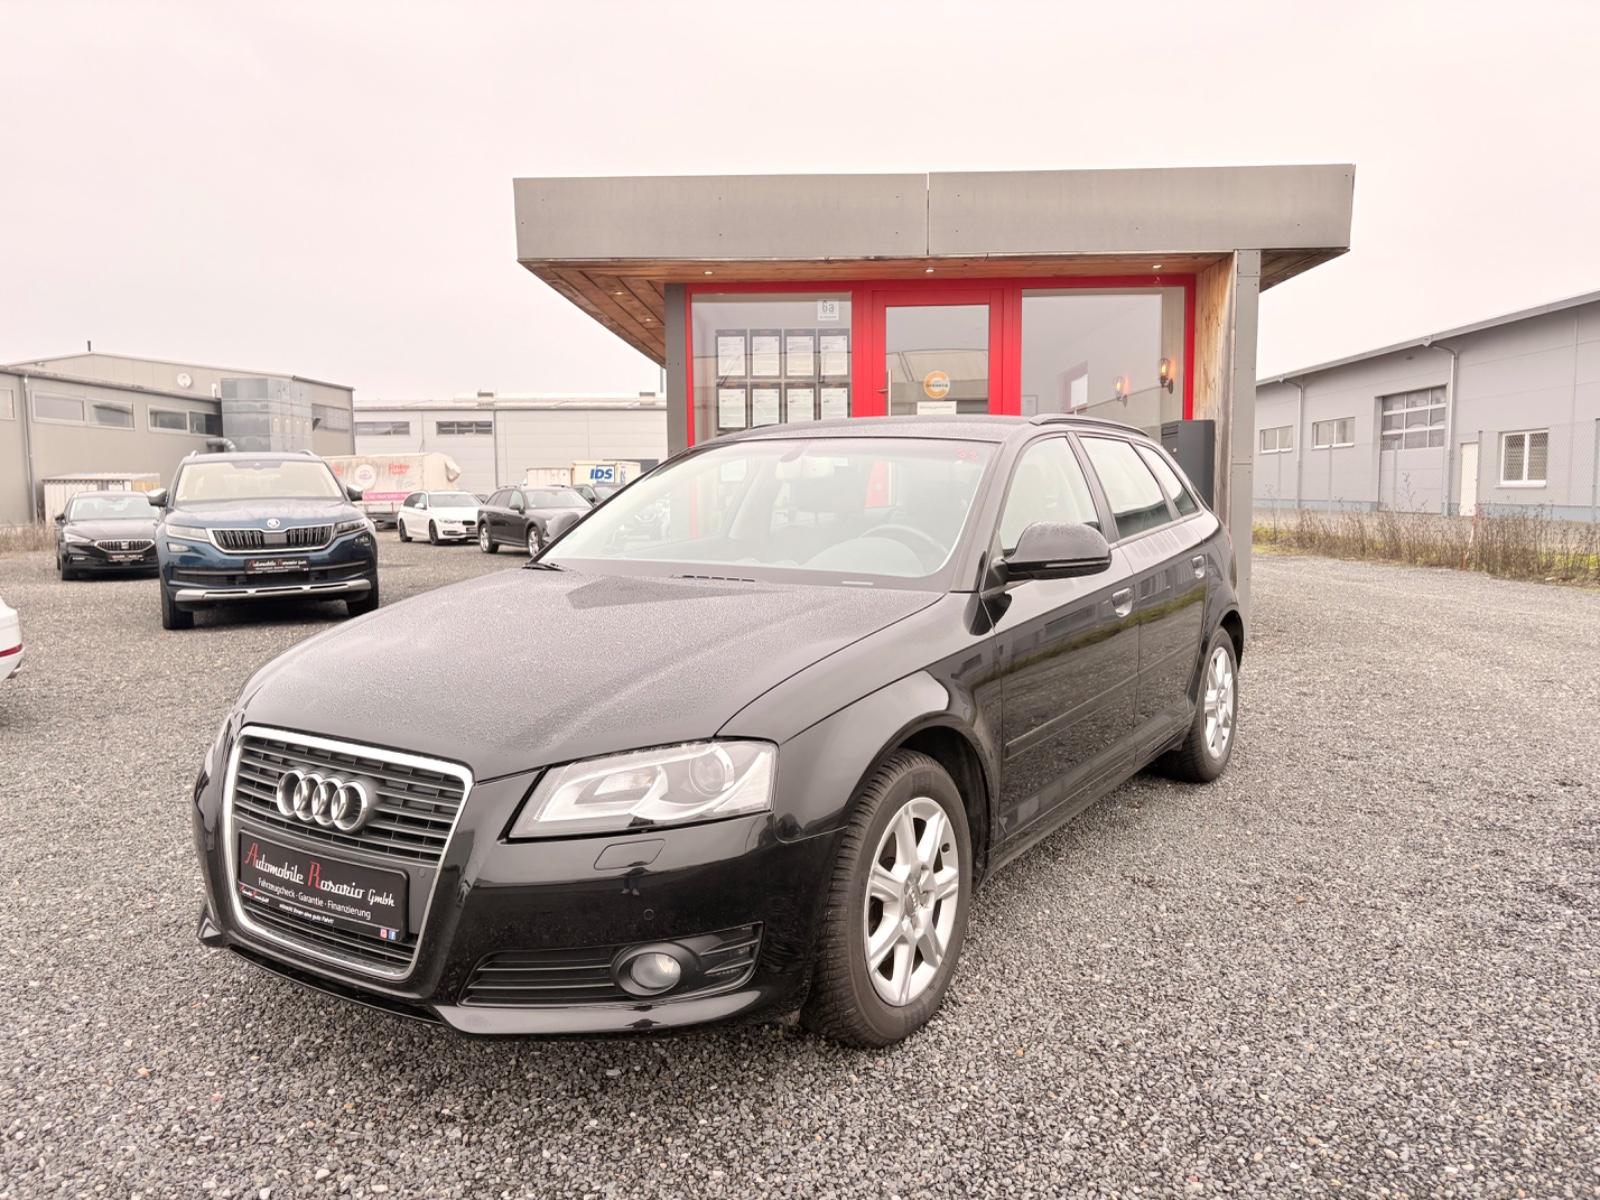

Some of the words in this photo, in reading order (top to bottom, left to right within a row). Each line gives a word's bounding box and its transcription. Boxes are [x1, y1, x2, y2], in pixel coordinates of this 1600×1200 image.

[590, 468, 613, 480] IDS
[243, 842, 304, 884] Automobile
[307, 861, 366, 899] Rosario
[298, 892, 324, 906] Garantie
[327, 900, 372, 920] Finanzierung
